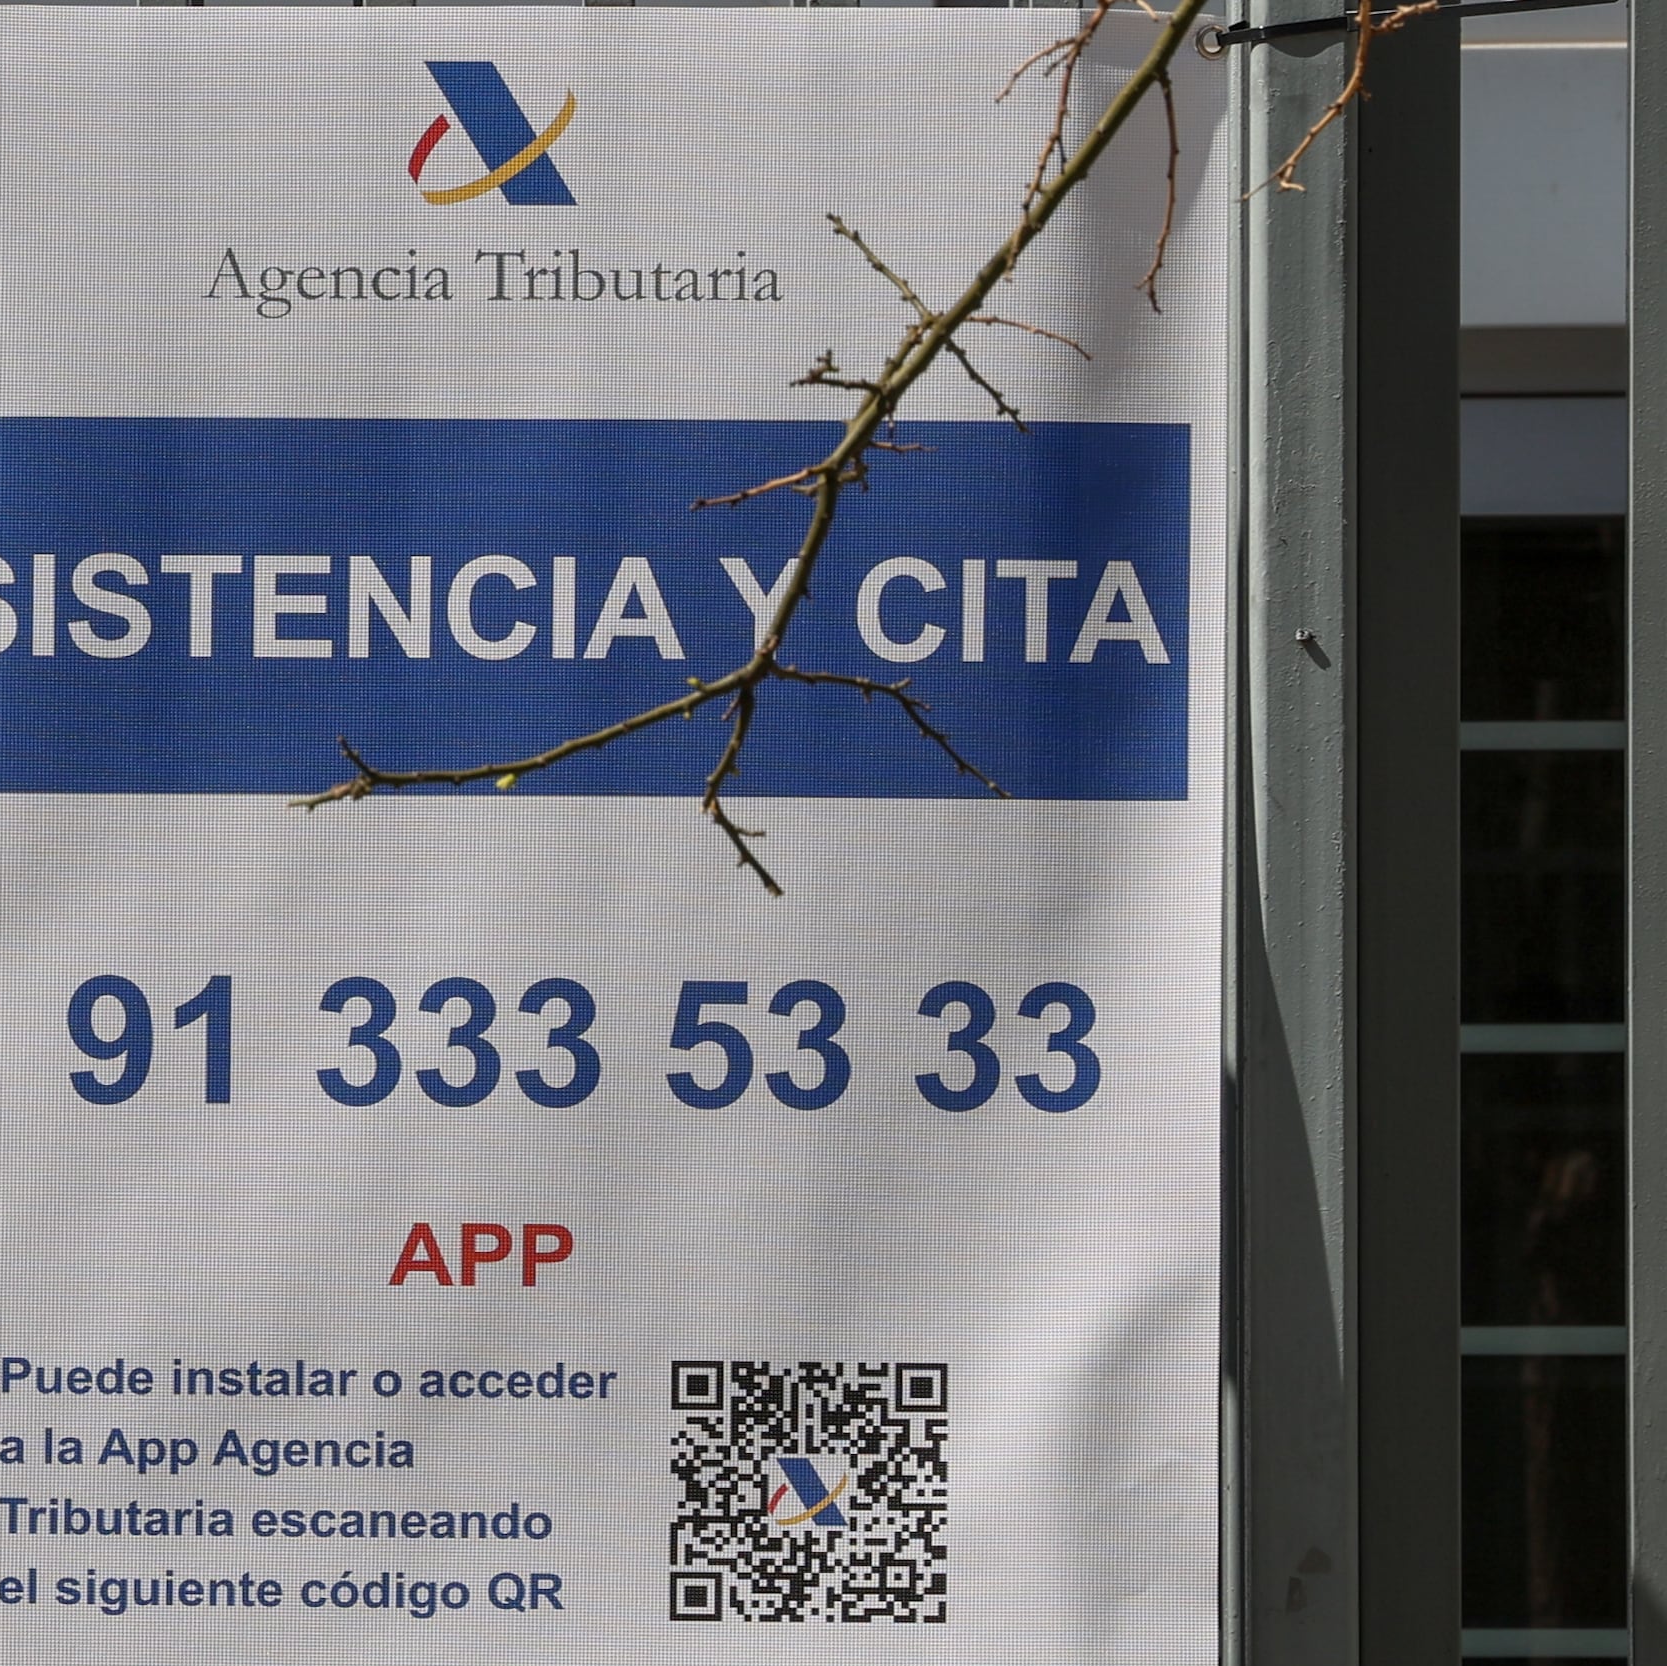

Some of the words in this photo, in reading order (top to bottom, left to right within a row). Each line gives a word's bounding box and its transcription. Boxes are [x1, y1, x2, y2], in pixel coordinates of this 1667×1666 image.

[202, 247, 453, 318] Agencia
[475, 248, 783, 304] Tributaria
[718, 555, 803, 662] Y
[855, 556, 1172, 666] CITA
[66, 974, 233, 1106] 91
[315, 976, 603, 1109] 333
[666, 979, 854, 1112] 53
[913, 980, 1103, 1114] 33
[387, 1221, 576, 1287] APP
[0, 1356, 154, 1397] Puede
[172, 1359, 358, 1398] instalar
[372, 1369, 403, 1398] o
[418, 1362, 618, 1400] acceder
[44, 1427, 83, 1466] la
[98, 1428, 199, 1475] App
[212, 1429, 415, 1477] Agencia
[251, 1502, 553, 1540] escaneando
[55, 1571, 283, 1616] siguiente
[300, 1571, 470, 1620] código
[487, 1571, 565, 1612] QR
